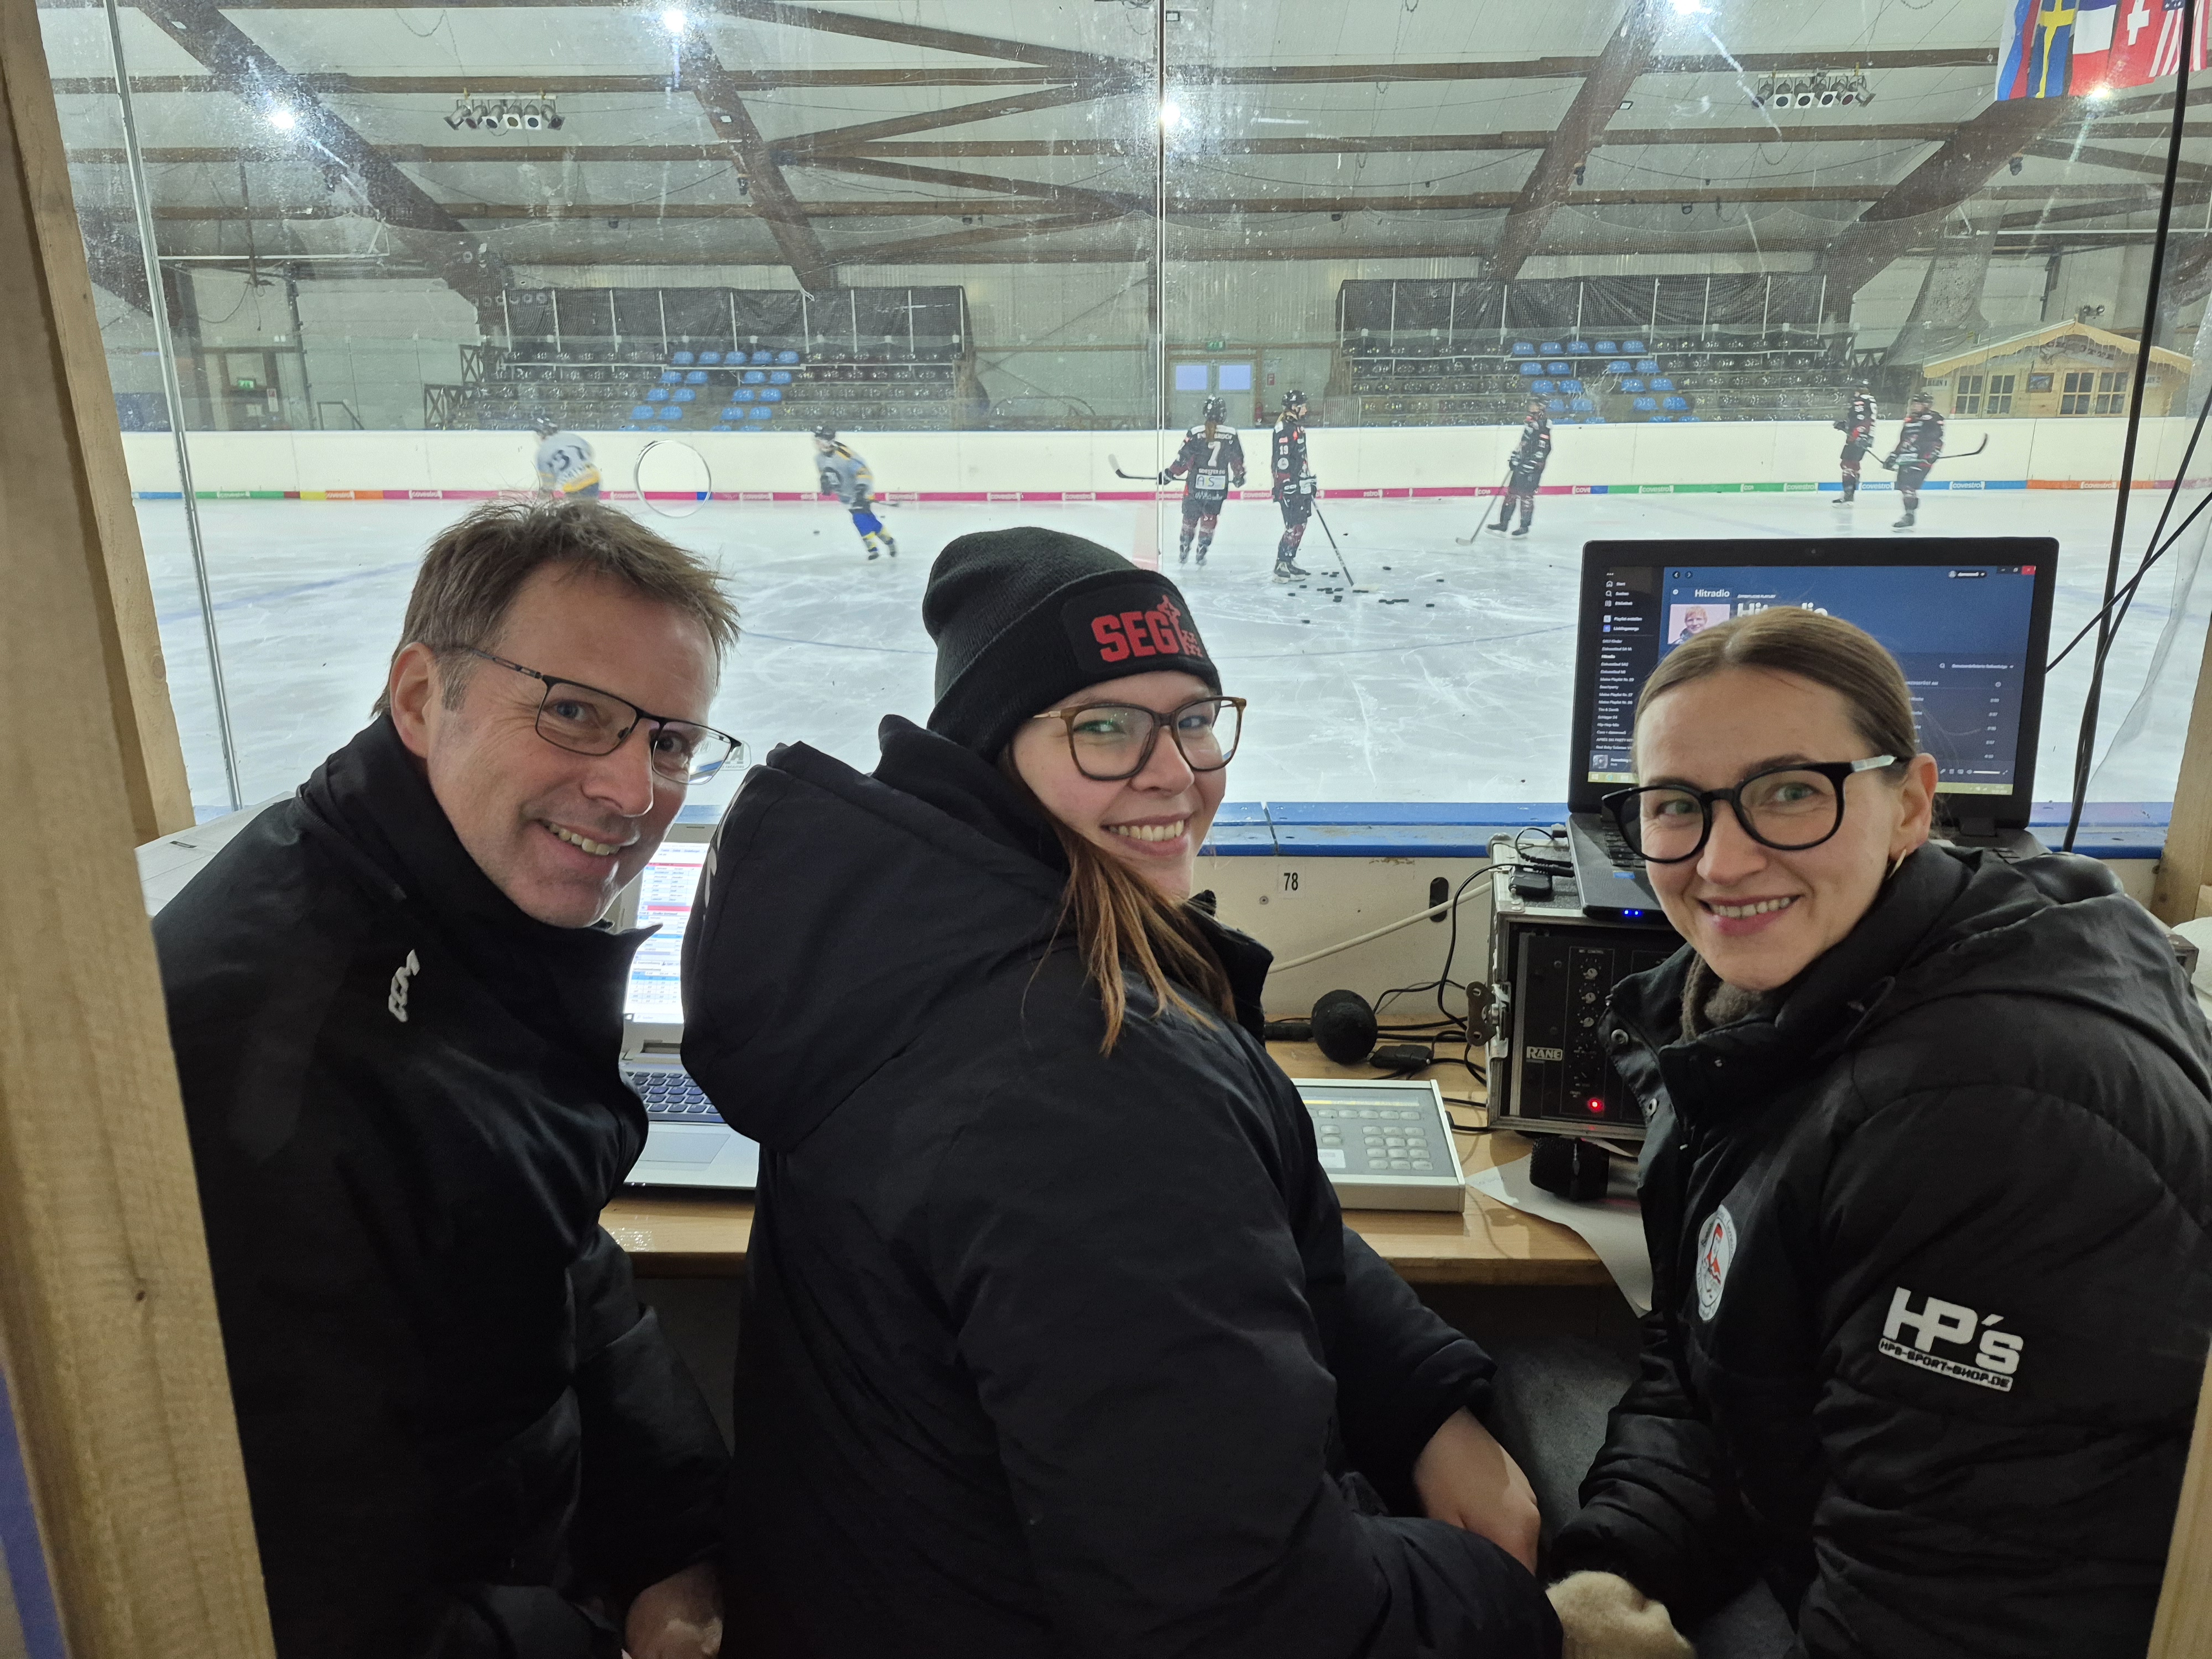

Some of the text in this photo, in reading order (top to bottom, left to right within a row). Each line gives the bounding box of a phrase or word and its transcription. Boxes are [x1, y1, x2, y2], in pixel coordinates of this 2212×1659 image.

[1208, 441, 1221, 467] 7
[1279, 445, 1288, 455] 19
[1694, 589, 1730, 597] Hitradio
[1091, 611, 1180, 662] SEG
[1284, 872, 1298, 891] 78
[1527, 1046, 1562, 1060] RANE
